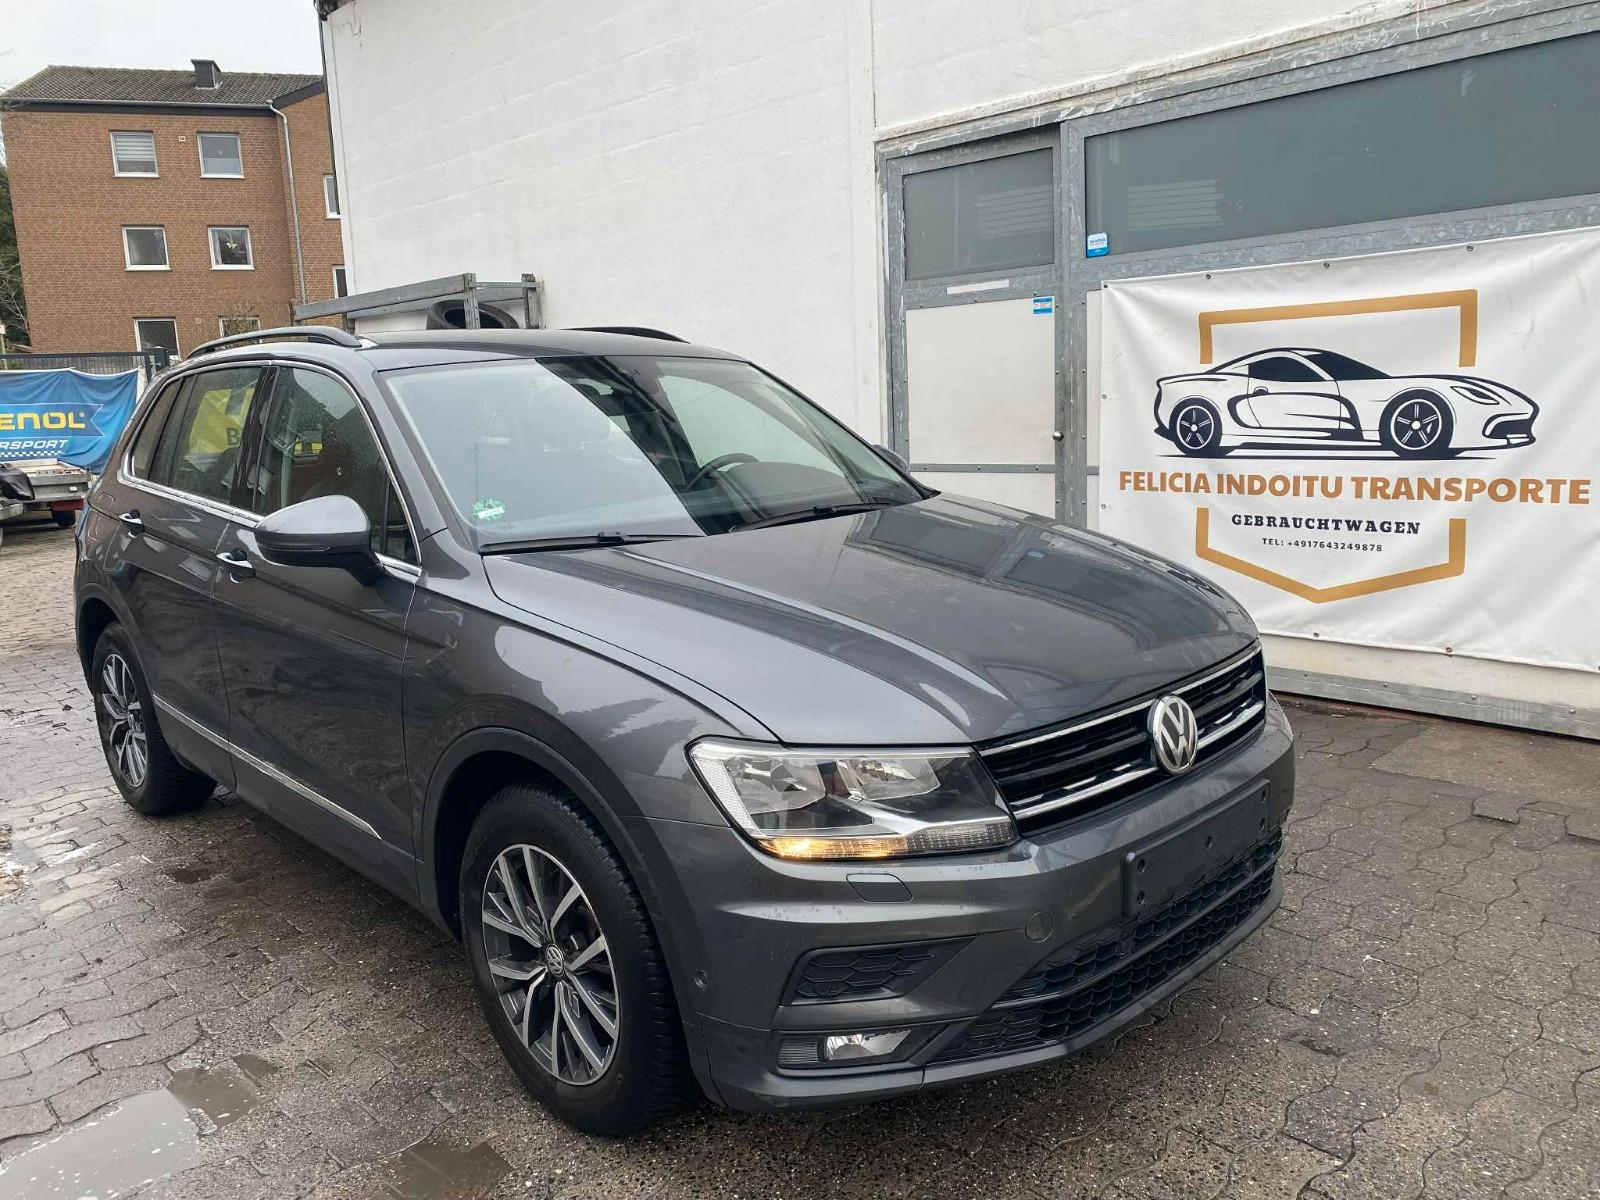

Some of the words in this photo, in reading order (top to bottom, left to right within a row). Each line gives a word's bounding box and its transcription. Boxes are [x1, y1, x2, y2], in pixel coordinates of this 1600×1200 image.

[1119, 471, 1211, 493] FELICIA
[1217, 474, 1343, 498] INDOITU
[1351, 476, 1590, 504] TRANSPORTE
[1231, 514, 1420, 534] GEBRAUCHTWAGEN
[1262, 538, 1284, 546] TEL:
[1288, 540, 1383, 552] +4917643249878
